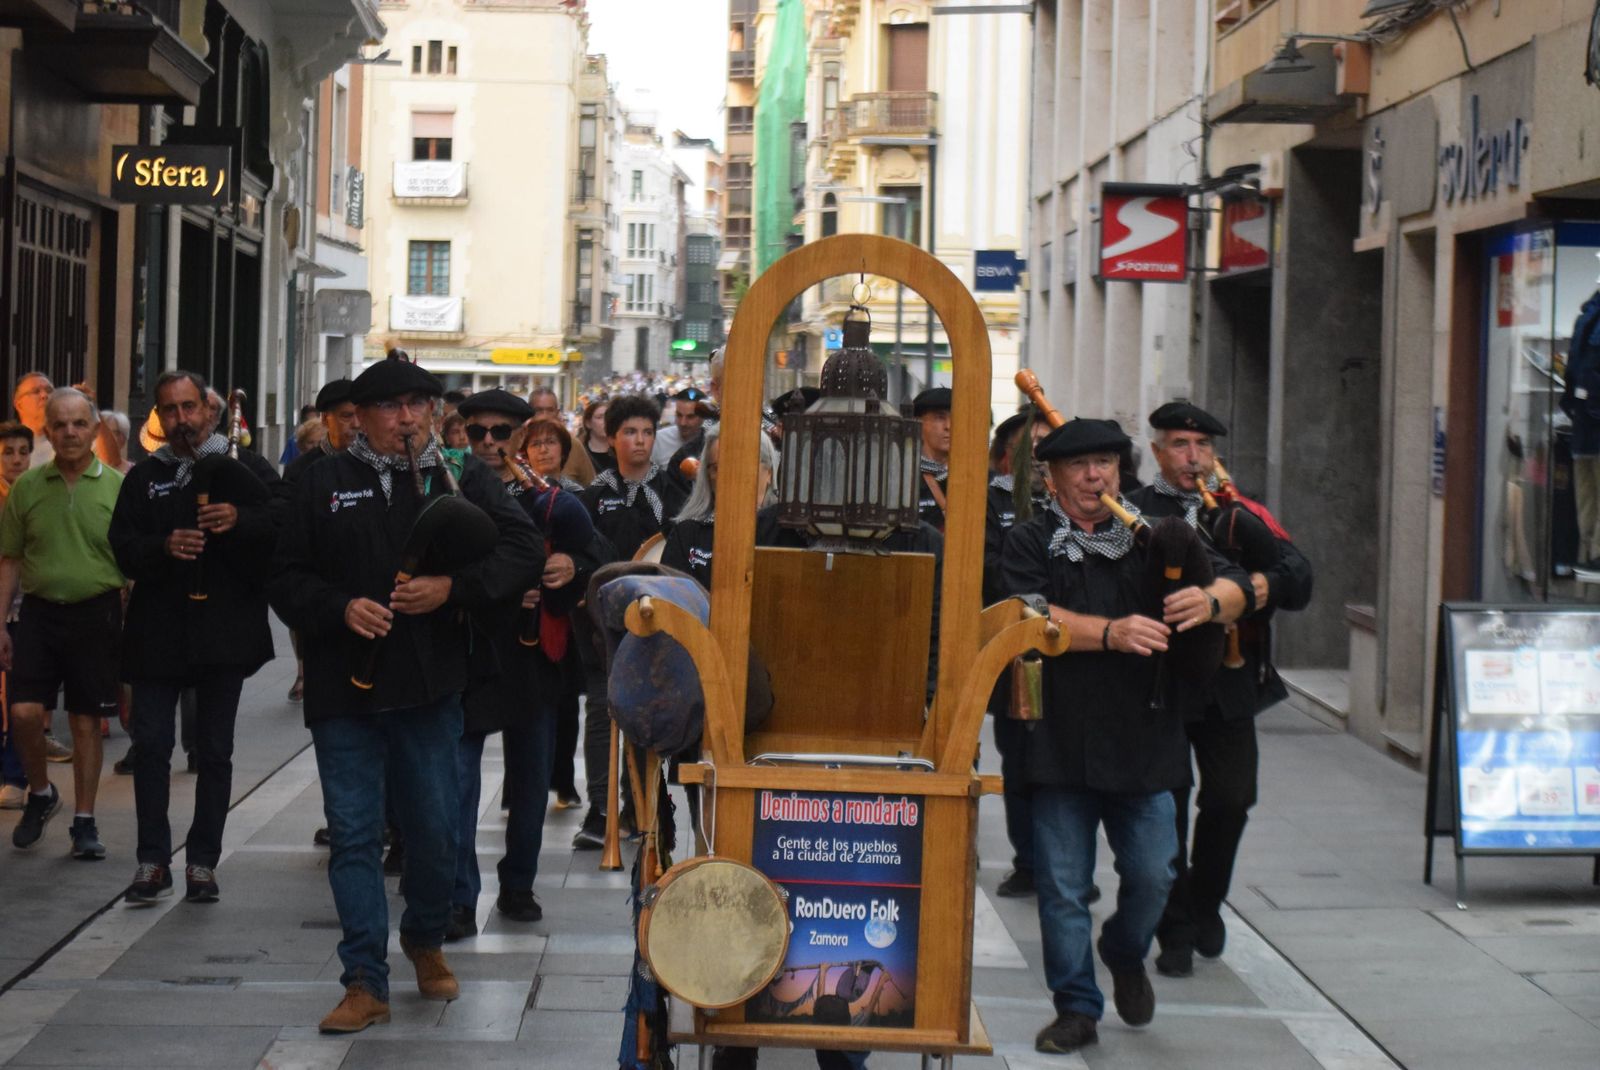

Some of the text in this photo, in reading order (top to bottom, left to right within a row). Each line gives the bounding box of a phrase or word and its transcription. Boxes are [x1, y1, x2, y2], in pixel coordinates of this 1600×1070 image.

[977, 266, 1014, 277] BBVA
[1108, 259, 1180, 273] SPORTIUM
[760, 791, 919, 826] Venimos a rondarte
[777, 836, 898, 855] Gente de los pueblos
[772, 849, 901, 865] a la ciudad de Zamora
[795, 896, 900, 922] RonDuero Folk
[809, 930, 848, 947] Zamora
